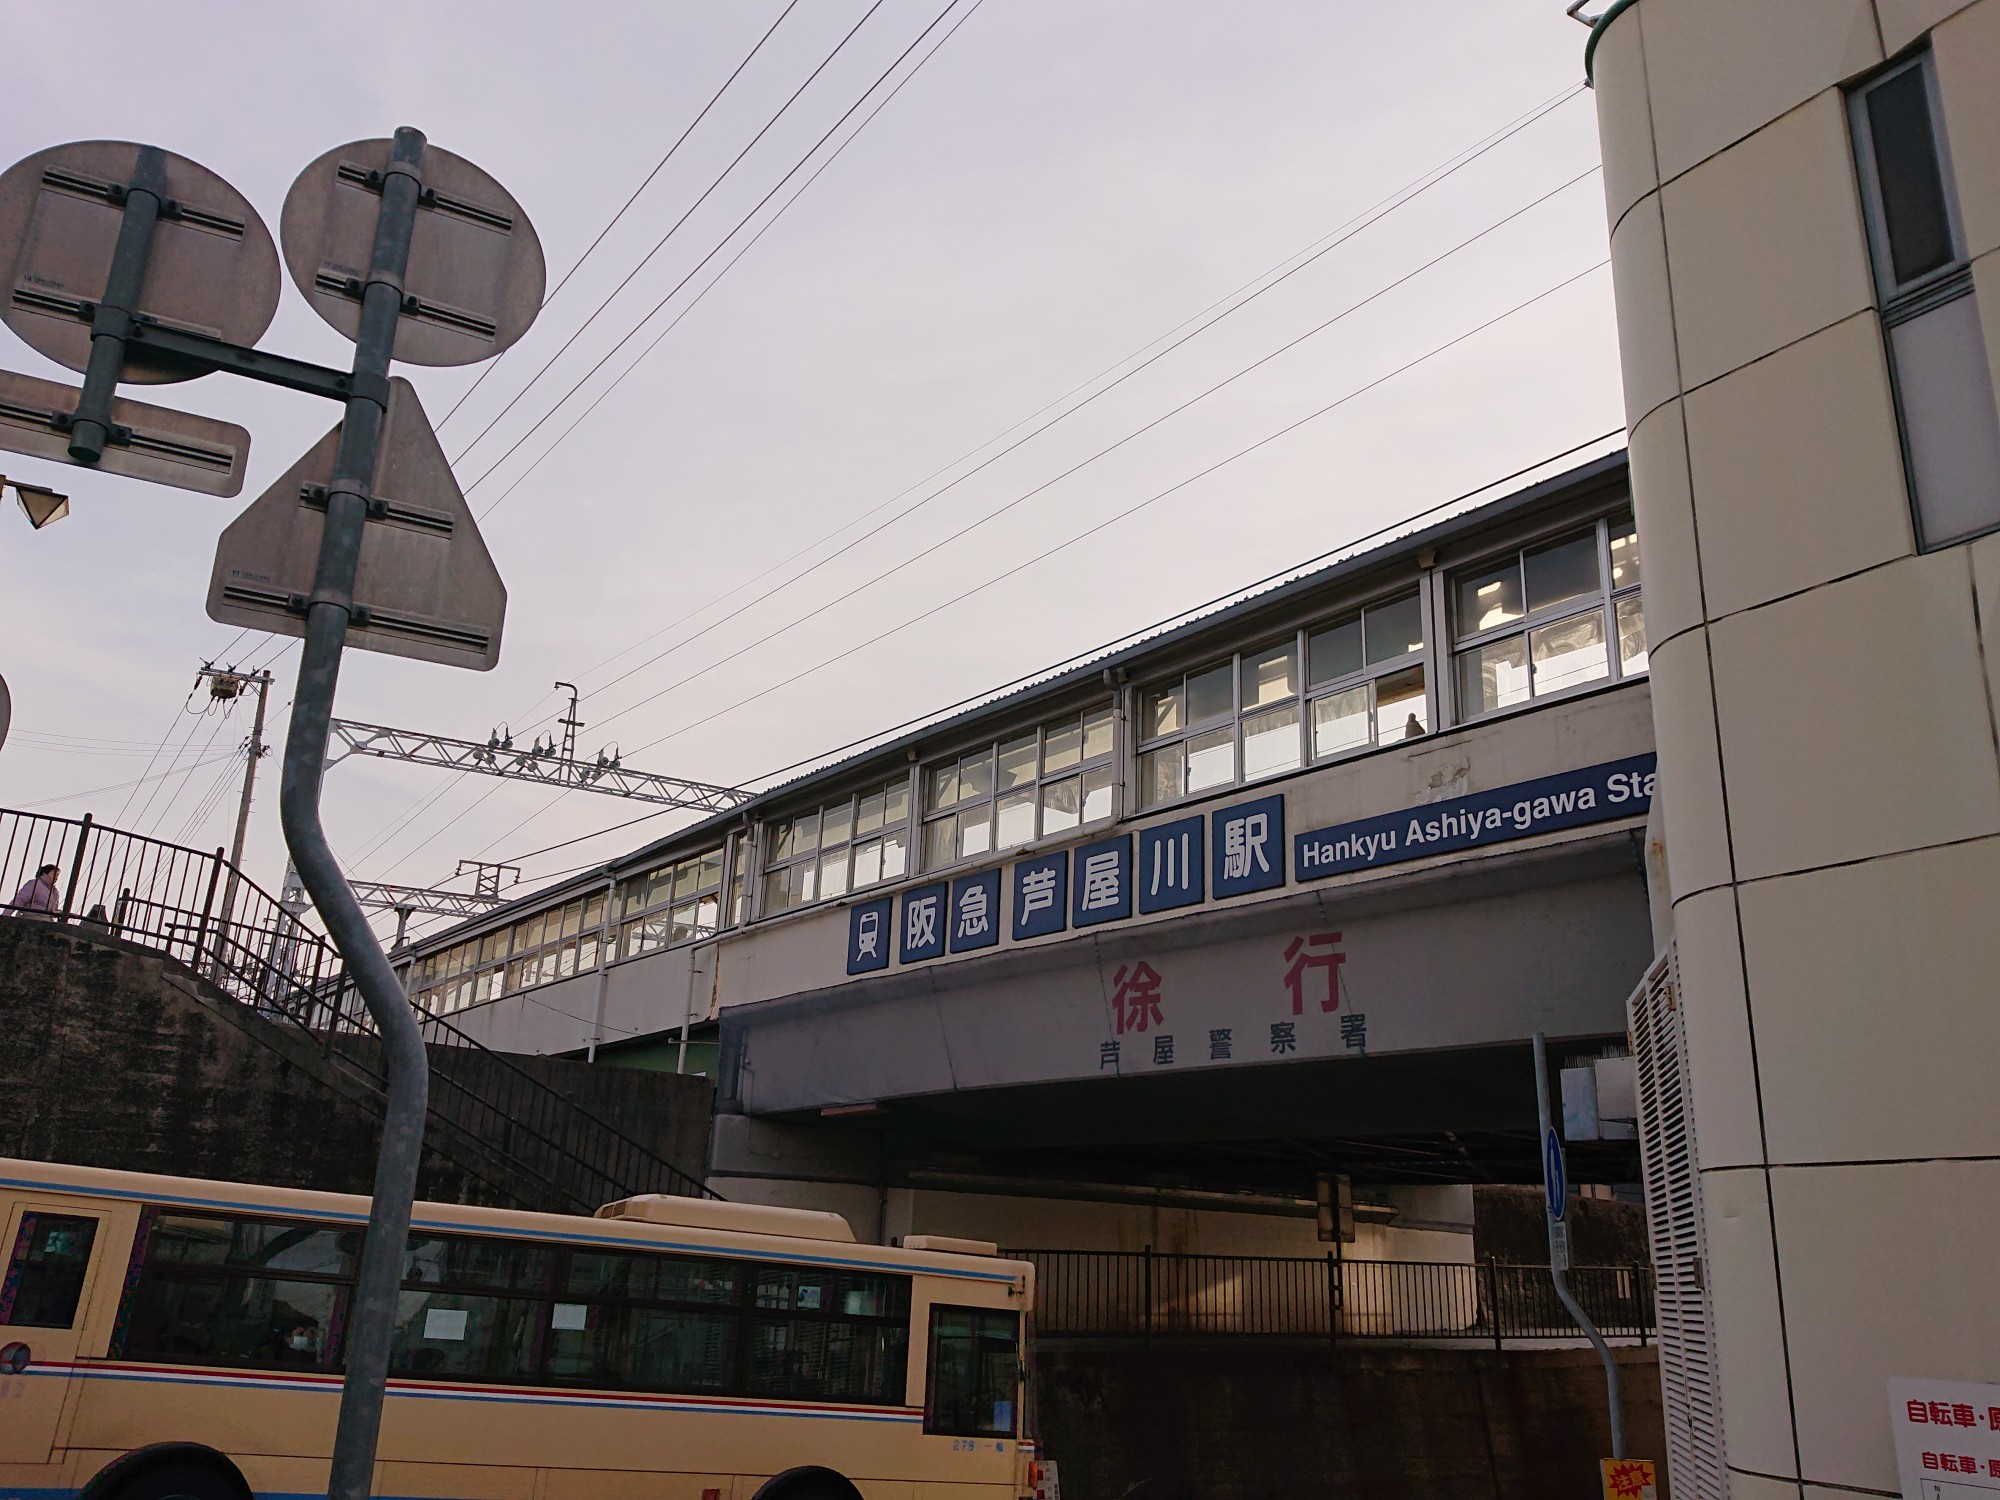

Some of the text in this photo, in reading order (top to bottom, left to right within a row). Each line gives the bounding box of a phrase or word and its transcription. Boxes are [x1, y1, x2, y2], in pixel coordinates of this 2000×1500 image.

[1303, 829, 1397, 868] Hankyu
[1405, 786, 1596, 846] Ashiya-gawa
[906, 813, 1270, 951] 阪急芦屋川駅
[1112, 931, 1346, 1035] 徐行
[1100, 1013, 1367, 1070] 芦屋警察署
